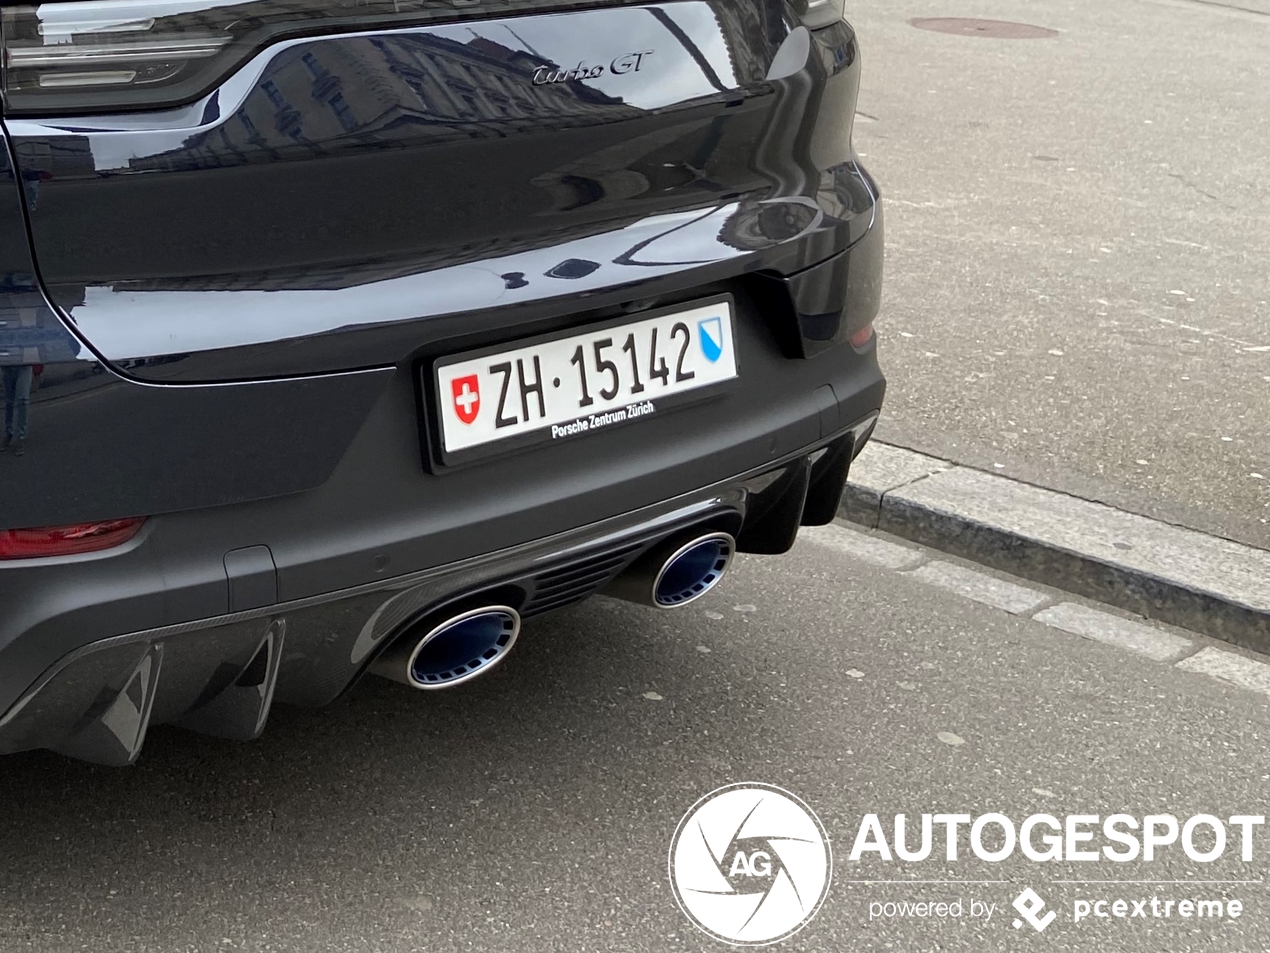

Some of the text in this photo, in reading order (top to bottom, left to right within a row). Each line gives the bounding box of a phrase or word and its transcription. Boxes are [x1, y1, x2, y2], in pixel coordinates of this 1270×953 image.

[610, 49, 654, 75] GT
[551, 400, 654, 439] Porsche Zentrum Zürich
